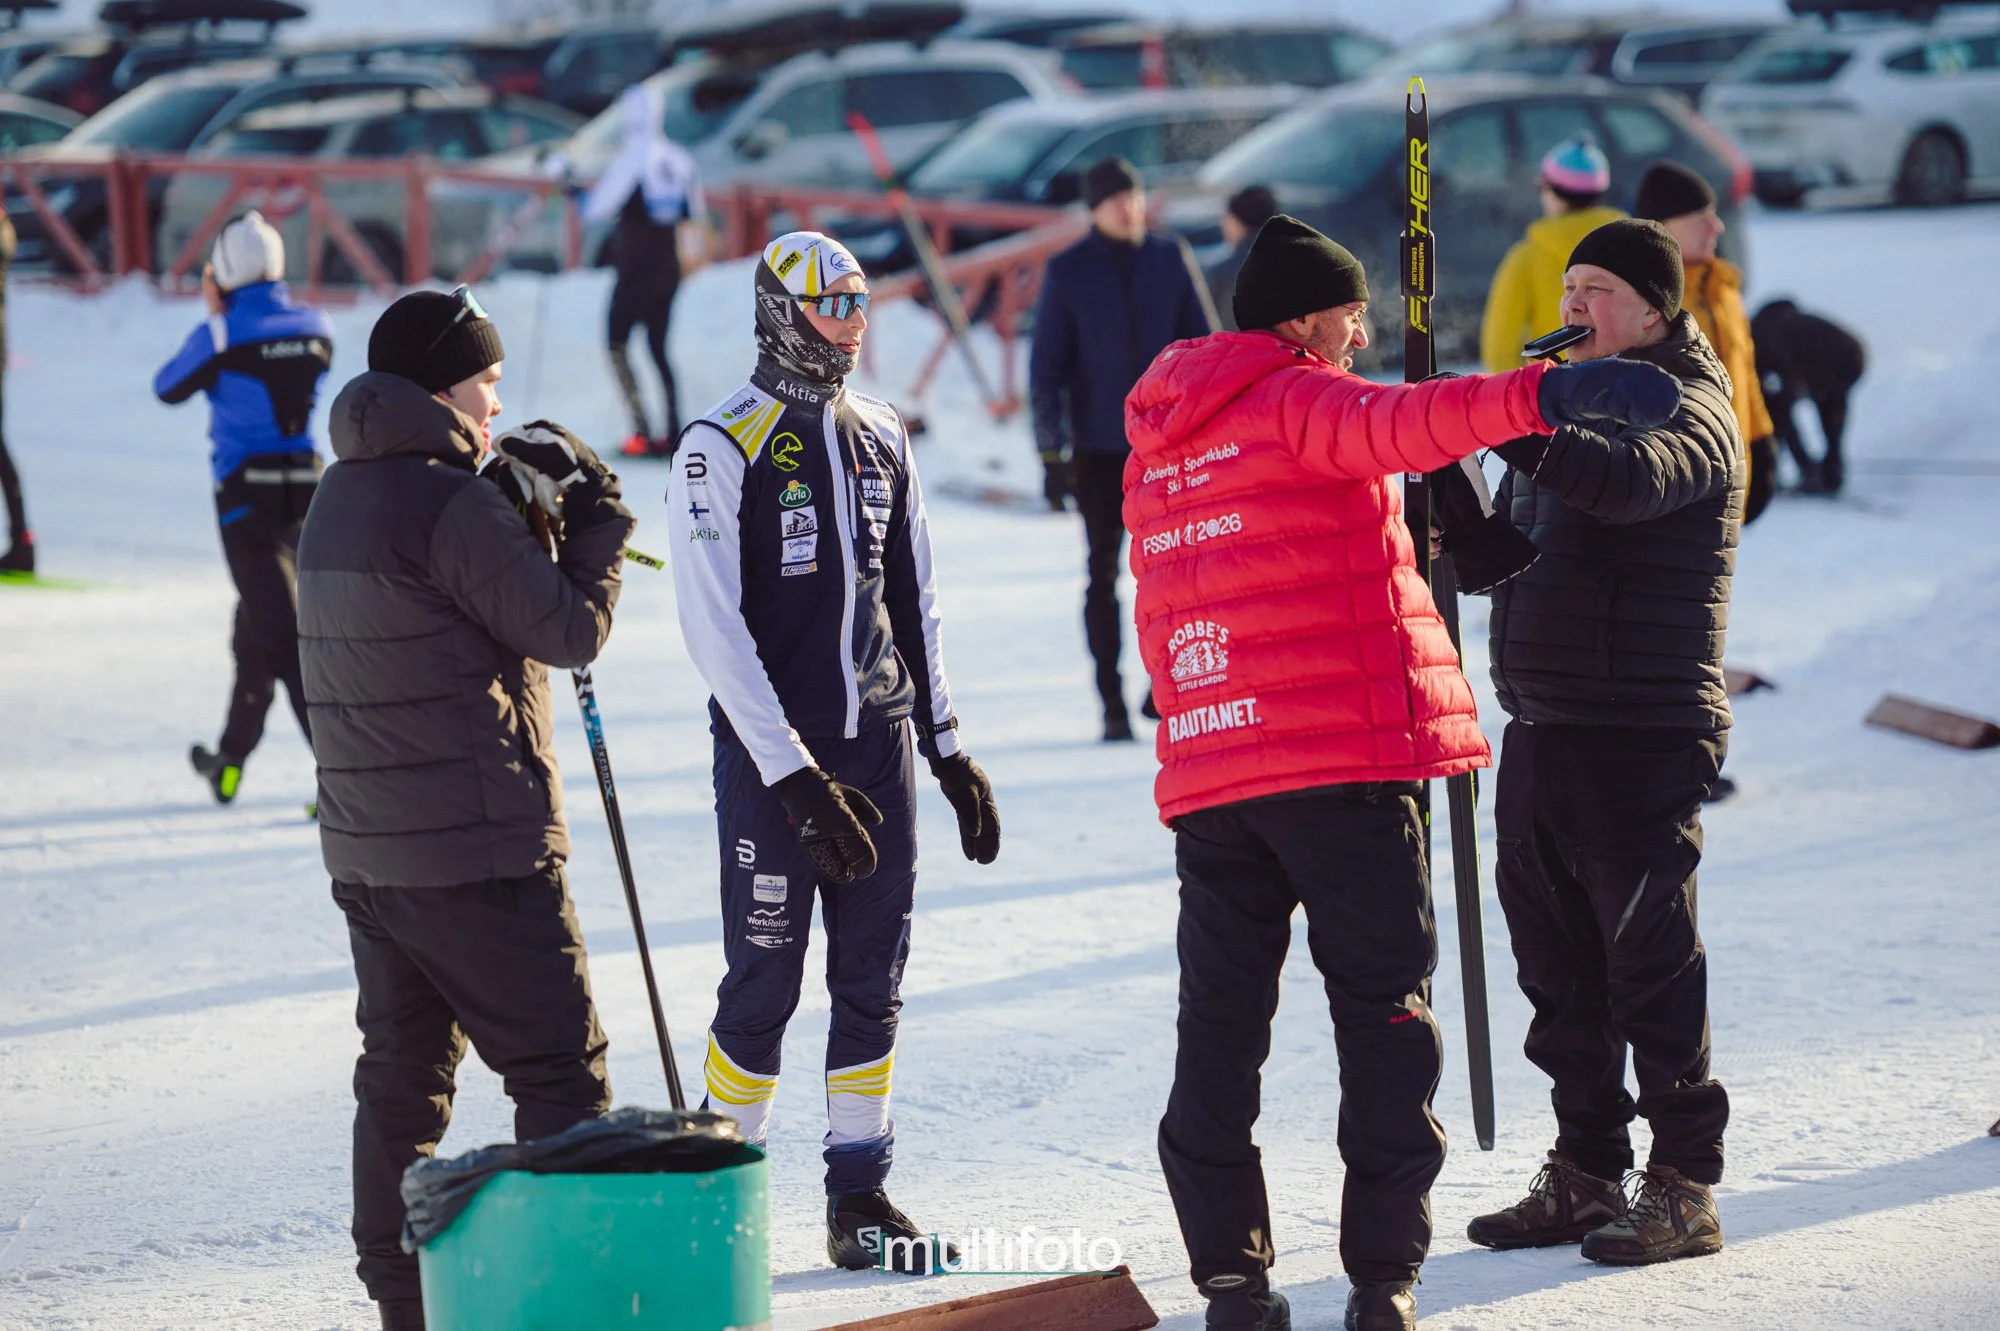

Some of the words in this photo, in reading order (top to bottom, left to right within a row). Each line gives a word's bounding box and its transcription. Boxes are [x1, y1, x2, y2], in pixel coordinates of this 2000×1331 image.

[776, 380, 818, 403] Aktia
[731, 396, 758, 416] ASPEN
[1143, 464, 1179, 484] Österby
[1184, 442, 1240, 472] Sportklubb
[1167, 479, 1182, 495] Ski
[1185, 472, 1210, 488] Team
[785, 489, 806, 502] Arla
[864, 490, 891, 501] SPORT
[690, 528, 720, 543] Aktia
[1142, 528, 1180, 557] FSSM
[1196, 513, 1242, 542] 2026
[1168, 620, 1230, 655] ROBBE'S
[1177, 679, 1199, 693] LITTLE
[1198, 674, 1228, 689] GARDEN
[747, 915, 790, 927] WorkRelax
